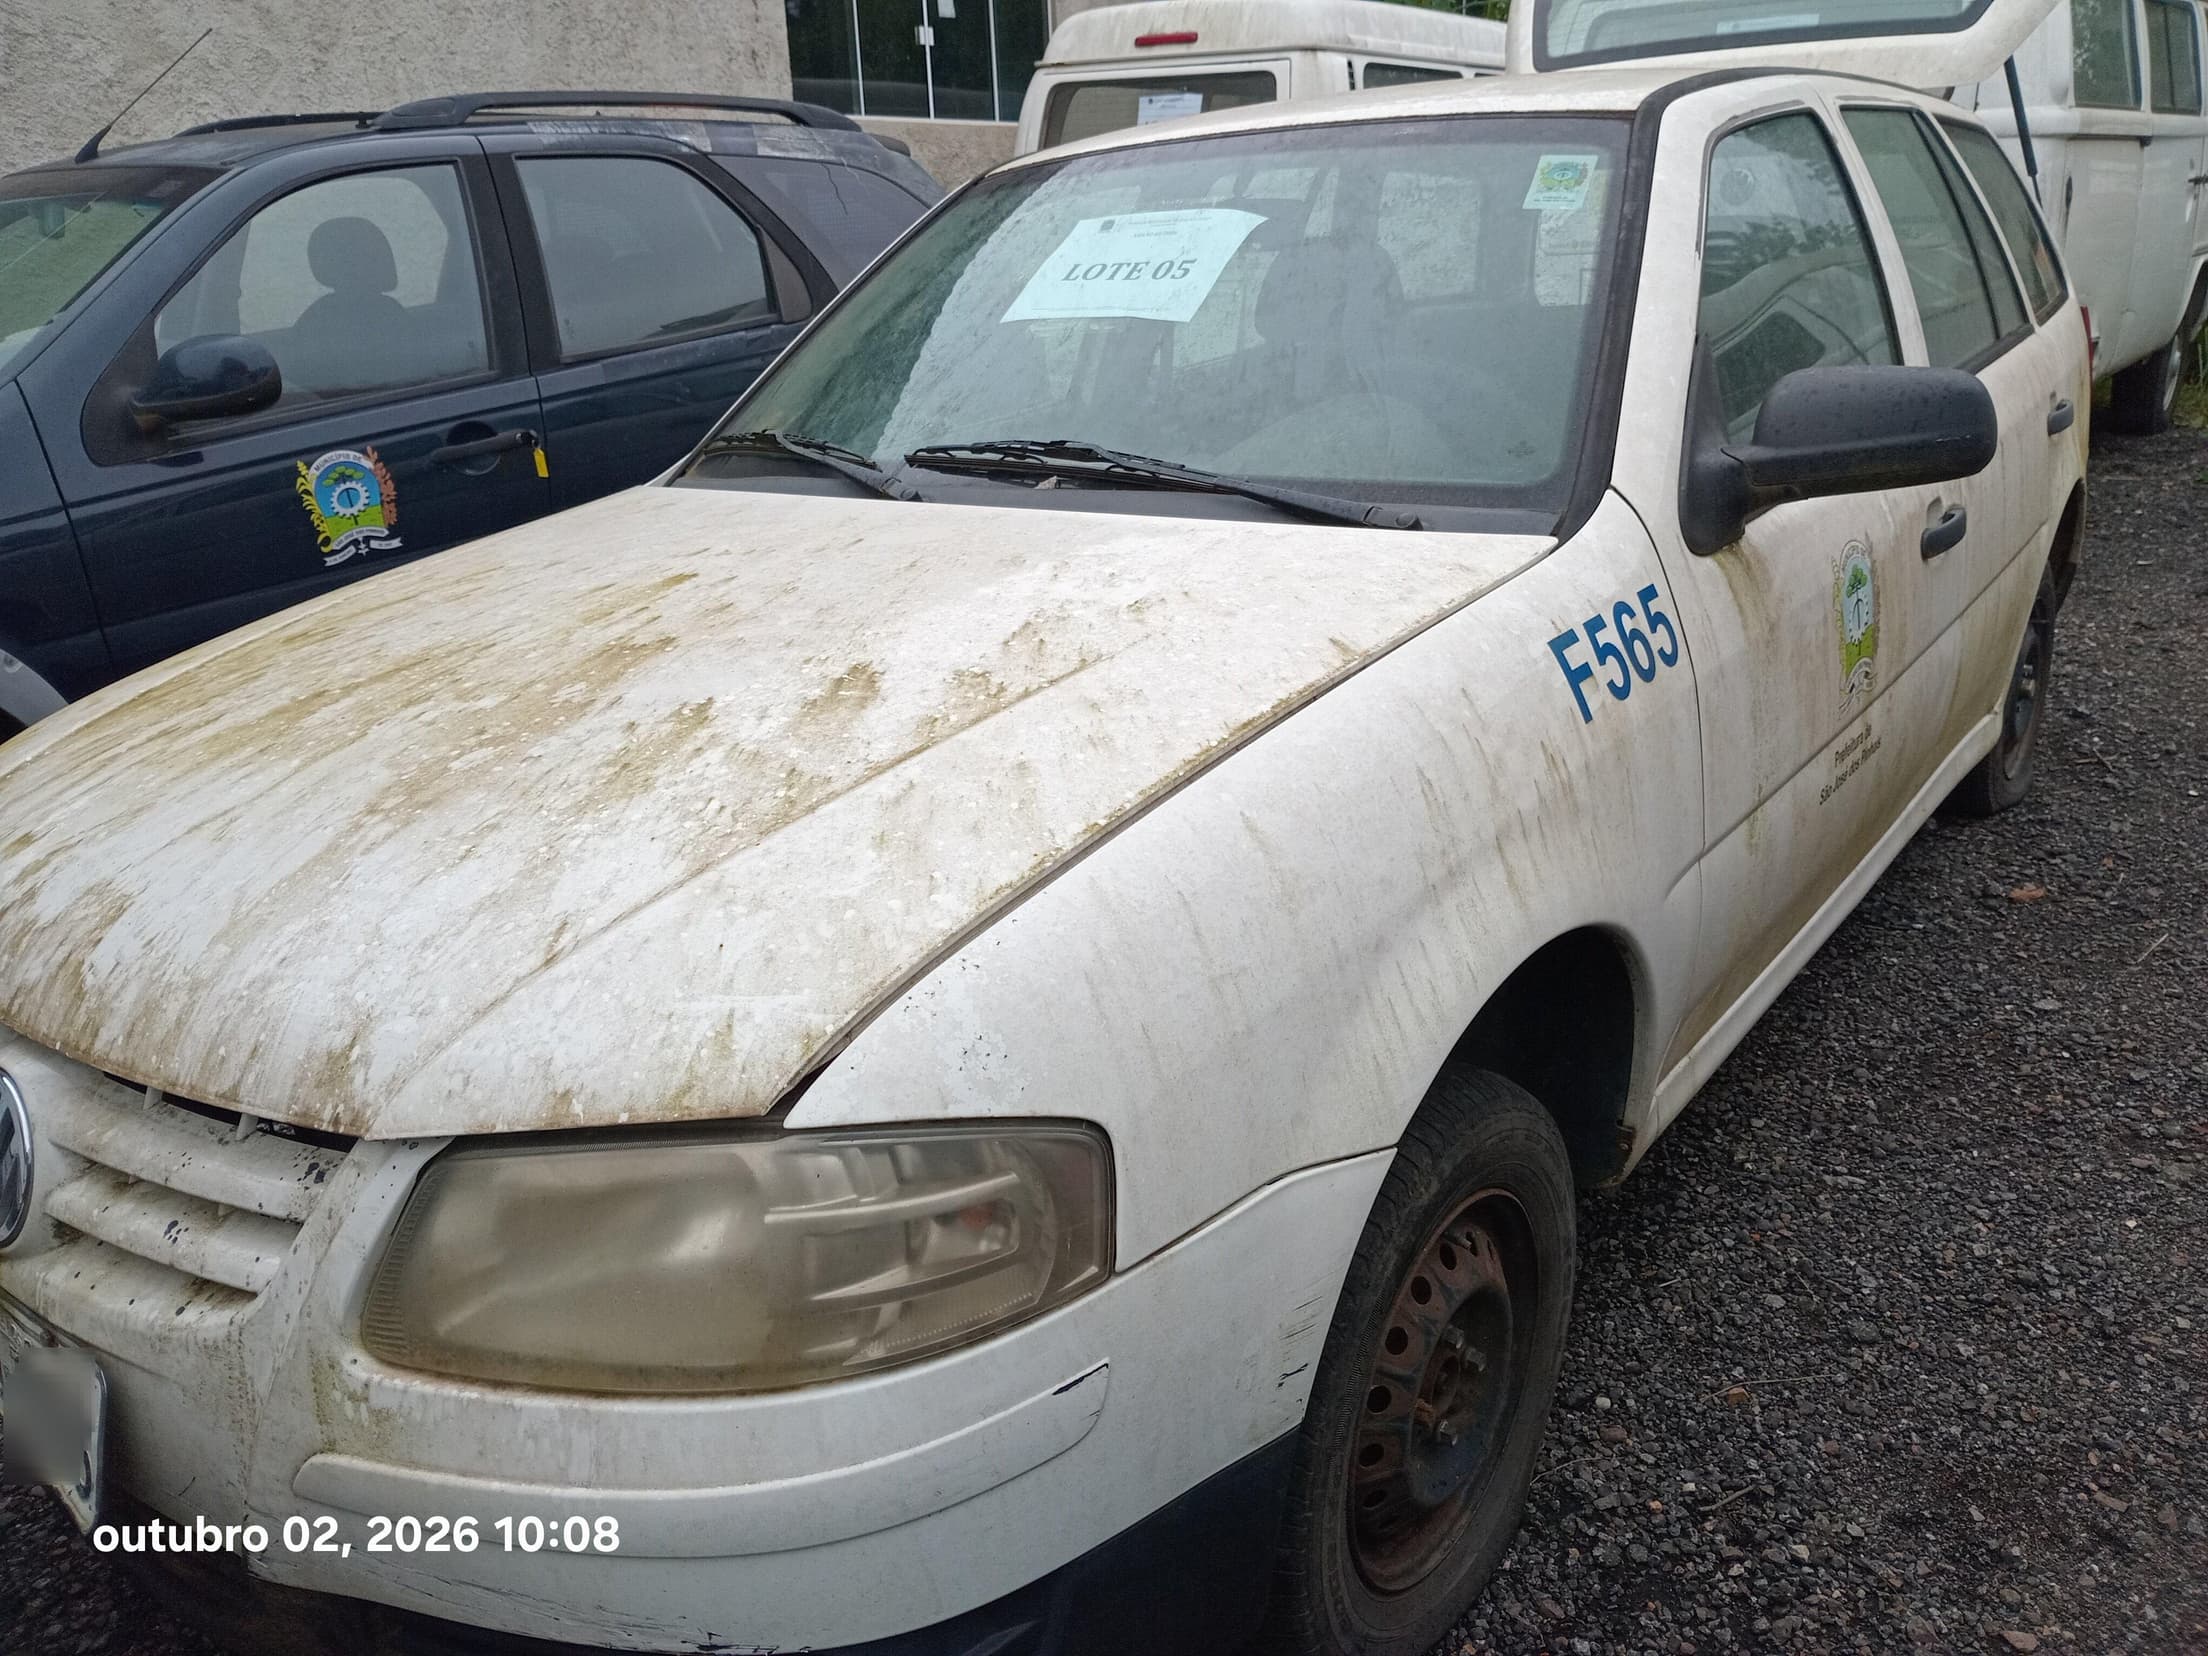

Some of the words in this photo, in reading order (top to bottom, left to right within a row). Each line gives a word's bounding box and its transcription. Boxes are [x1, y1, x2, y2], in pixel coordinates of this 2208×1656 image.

[1061, 261, 1150, 281] LOTE
[1151, 258, 1197, 280] 05
[1547, 583, 1679, 724] F565
